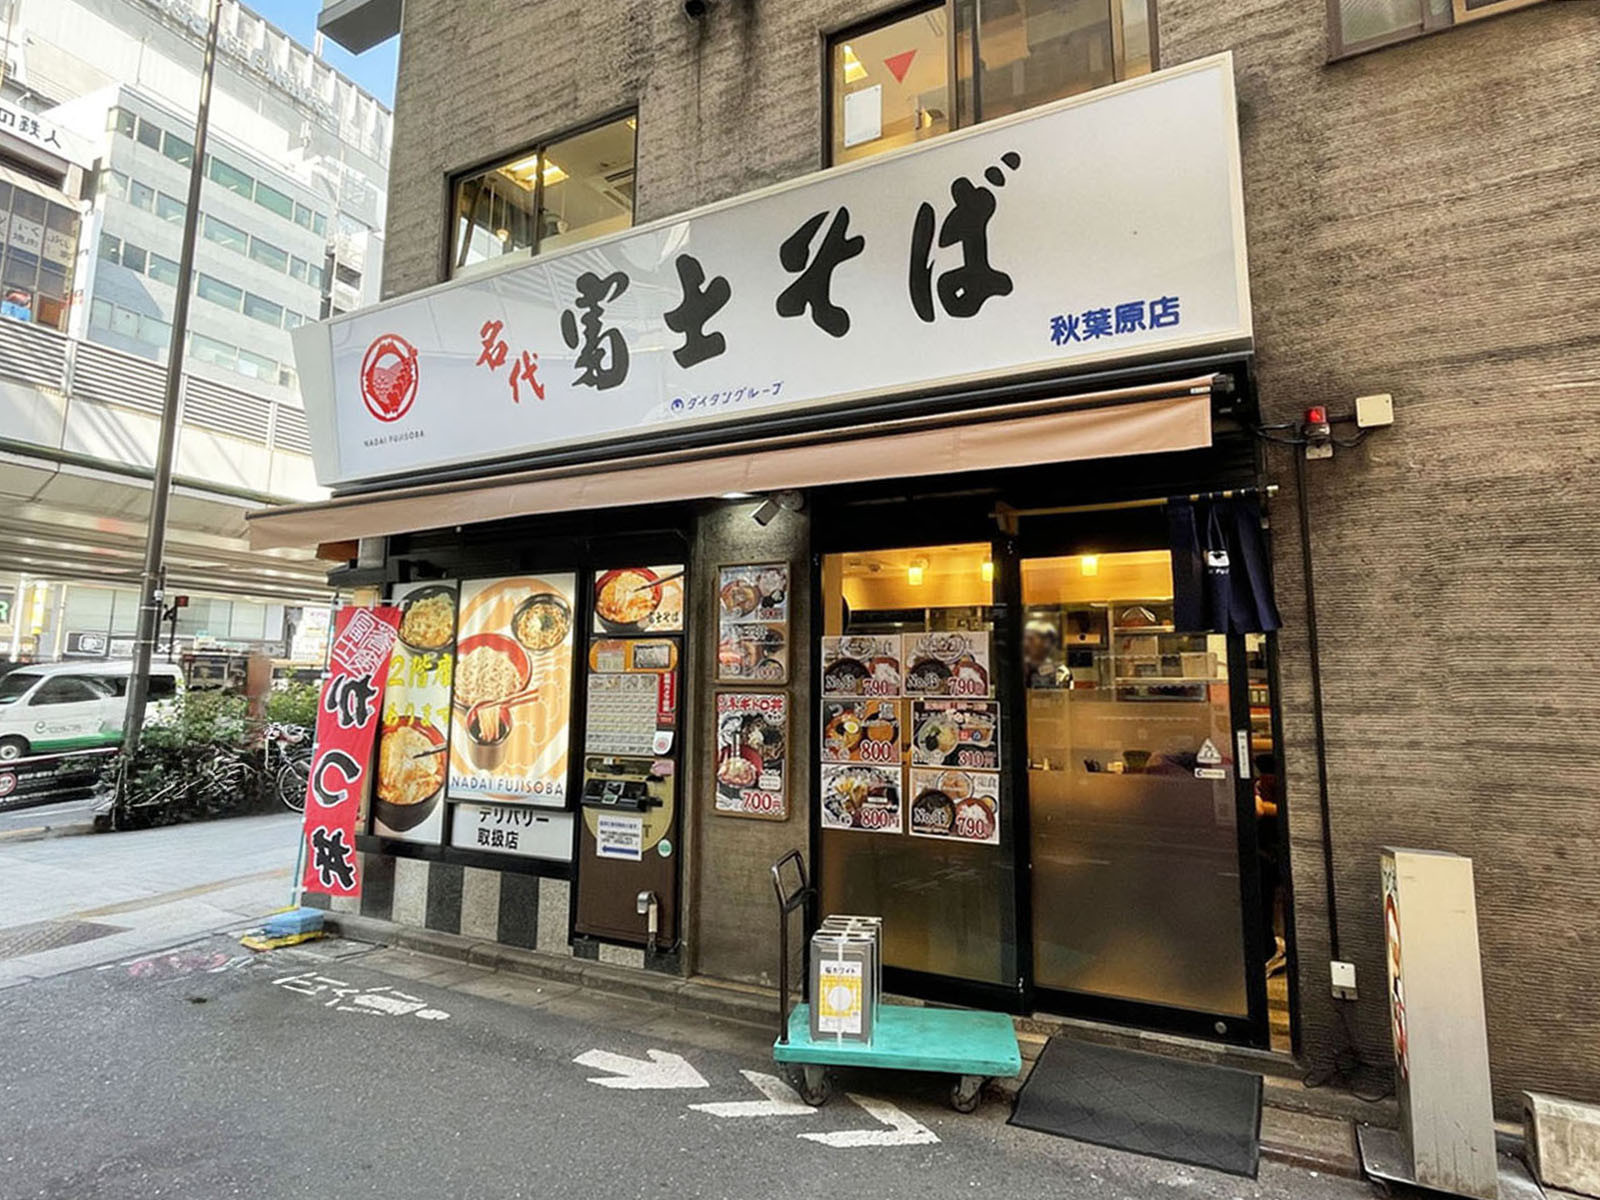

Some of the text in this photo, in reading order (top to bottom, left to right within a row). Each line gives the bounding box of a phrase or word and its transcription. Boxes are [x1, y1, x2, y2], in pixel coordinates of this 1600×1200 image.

[561, 151, 1022, 390] 富士そば
[1049, 296, 1181, 346] 秋葉原店
[476, 319, 545, 403] 名代
[687, 380, 784, 410] ダイタングループ
[363, 430, 425, 448] NADAI FUJISOBA
[451, 776, 564, 796] NADAI FUJISOBA
[479, 807, 550, 826] デリバリー
[477, 827, 519, 850] 取扱店
